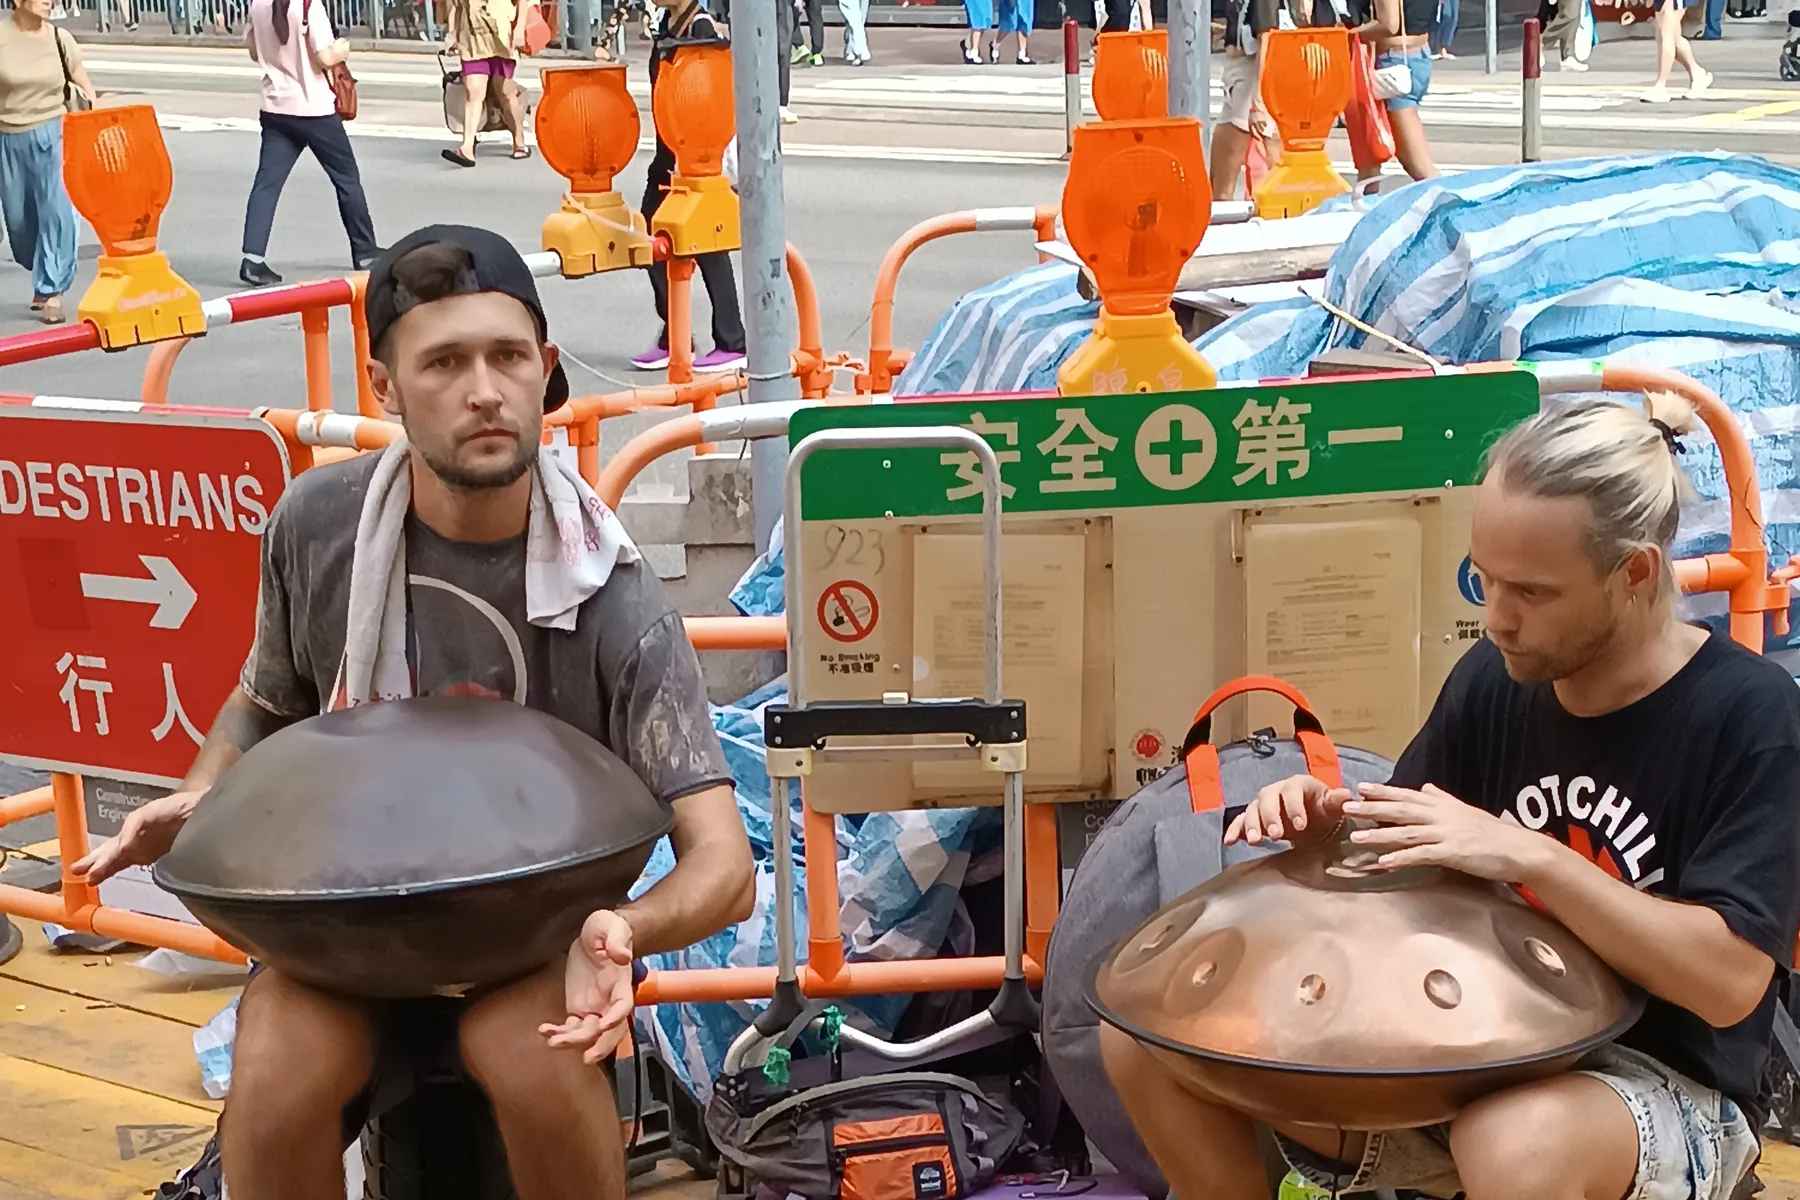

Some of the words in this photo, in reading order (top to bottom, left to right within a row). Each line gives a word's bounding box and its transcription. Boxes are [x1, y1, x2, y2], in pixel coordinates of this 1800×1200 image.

[940, 407, 1119, 501] 安全
[1232, 396, 1403, 489] 第一
[813, 524, 885, 577] 923
[55, 652, 207, 751] 行人
